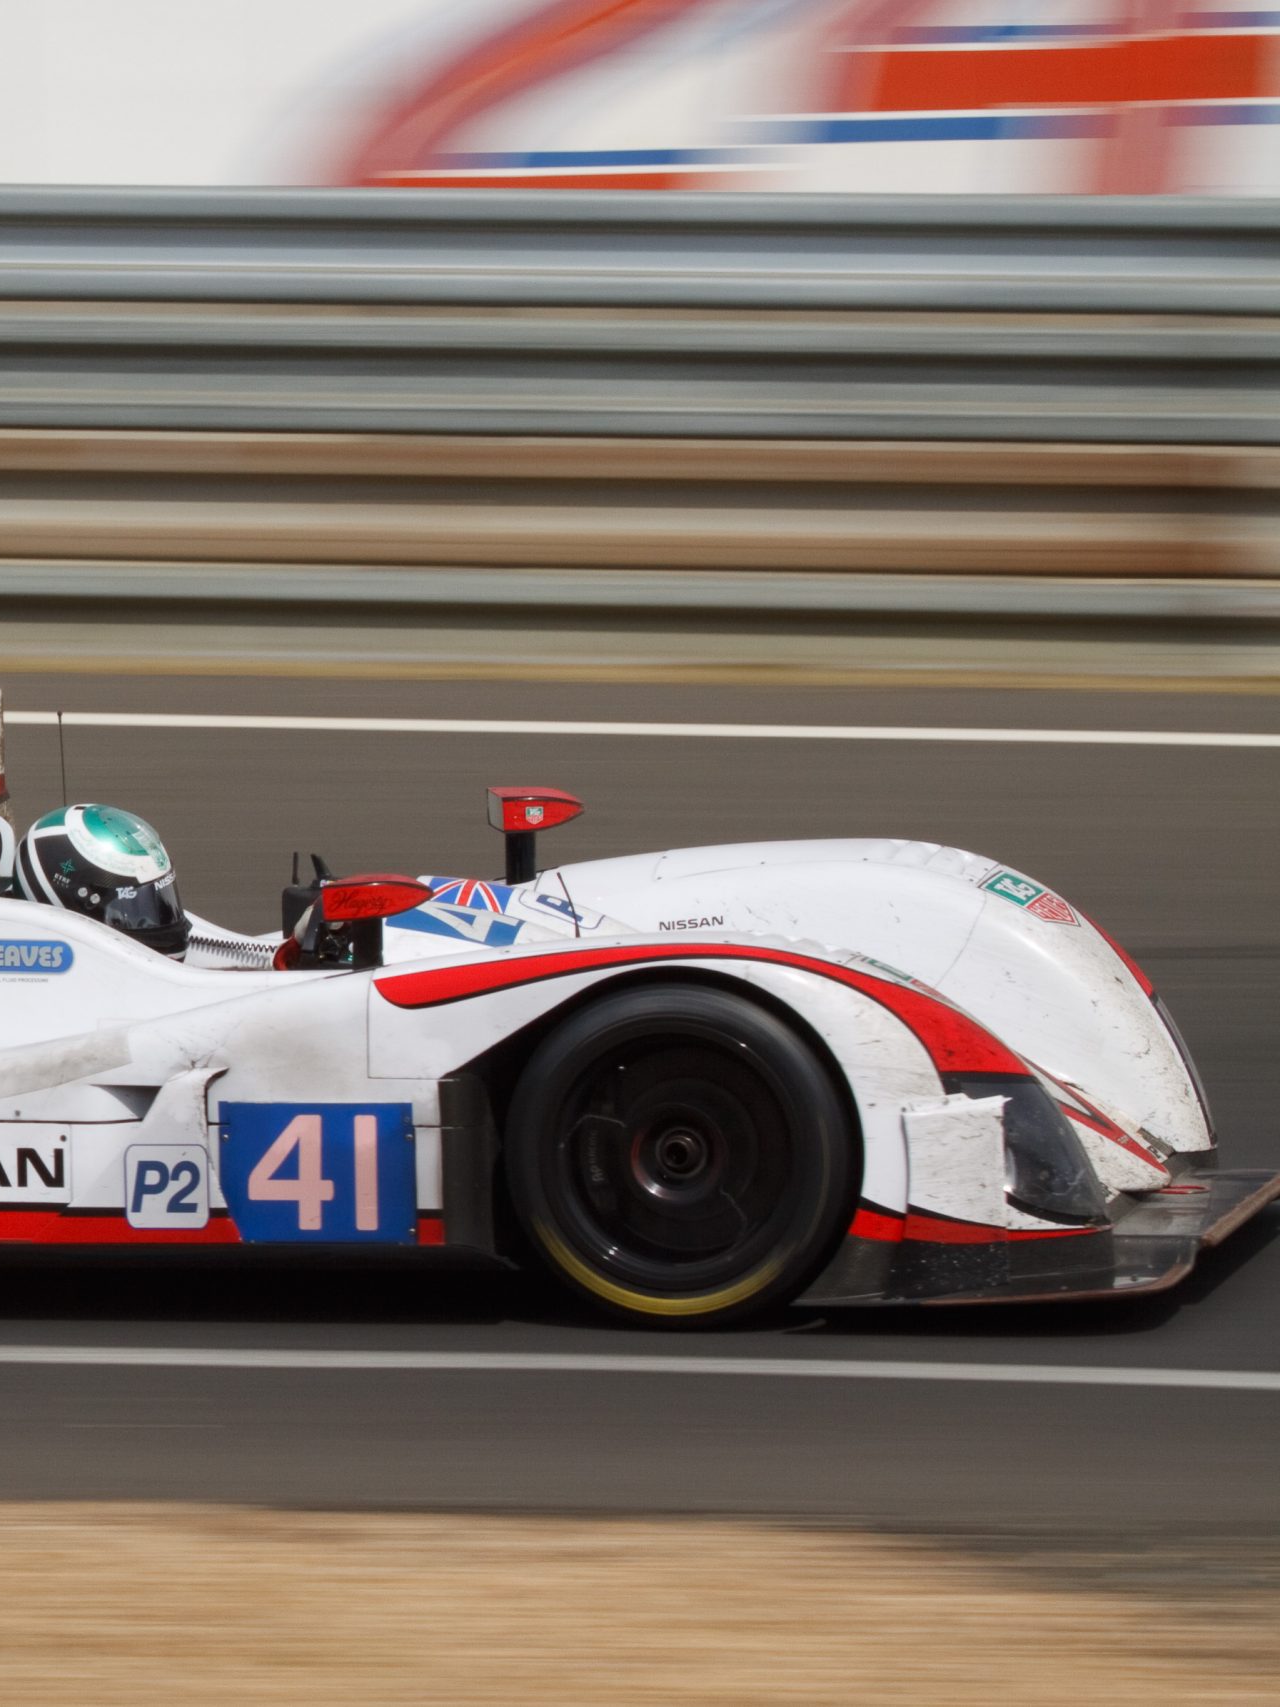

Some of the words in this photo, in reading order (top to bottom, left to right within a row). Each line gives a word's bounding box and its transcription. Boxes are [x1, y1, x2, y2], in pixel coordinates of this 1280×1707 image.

[115, 886, 137, 899] TAG
[659, 915, 723, 931] NISSAN
[131, 1160, 201, 1213] P2
[248, 1114, 378, 1231] 41
